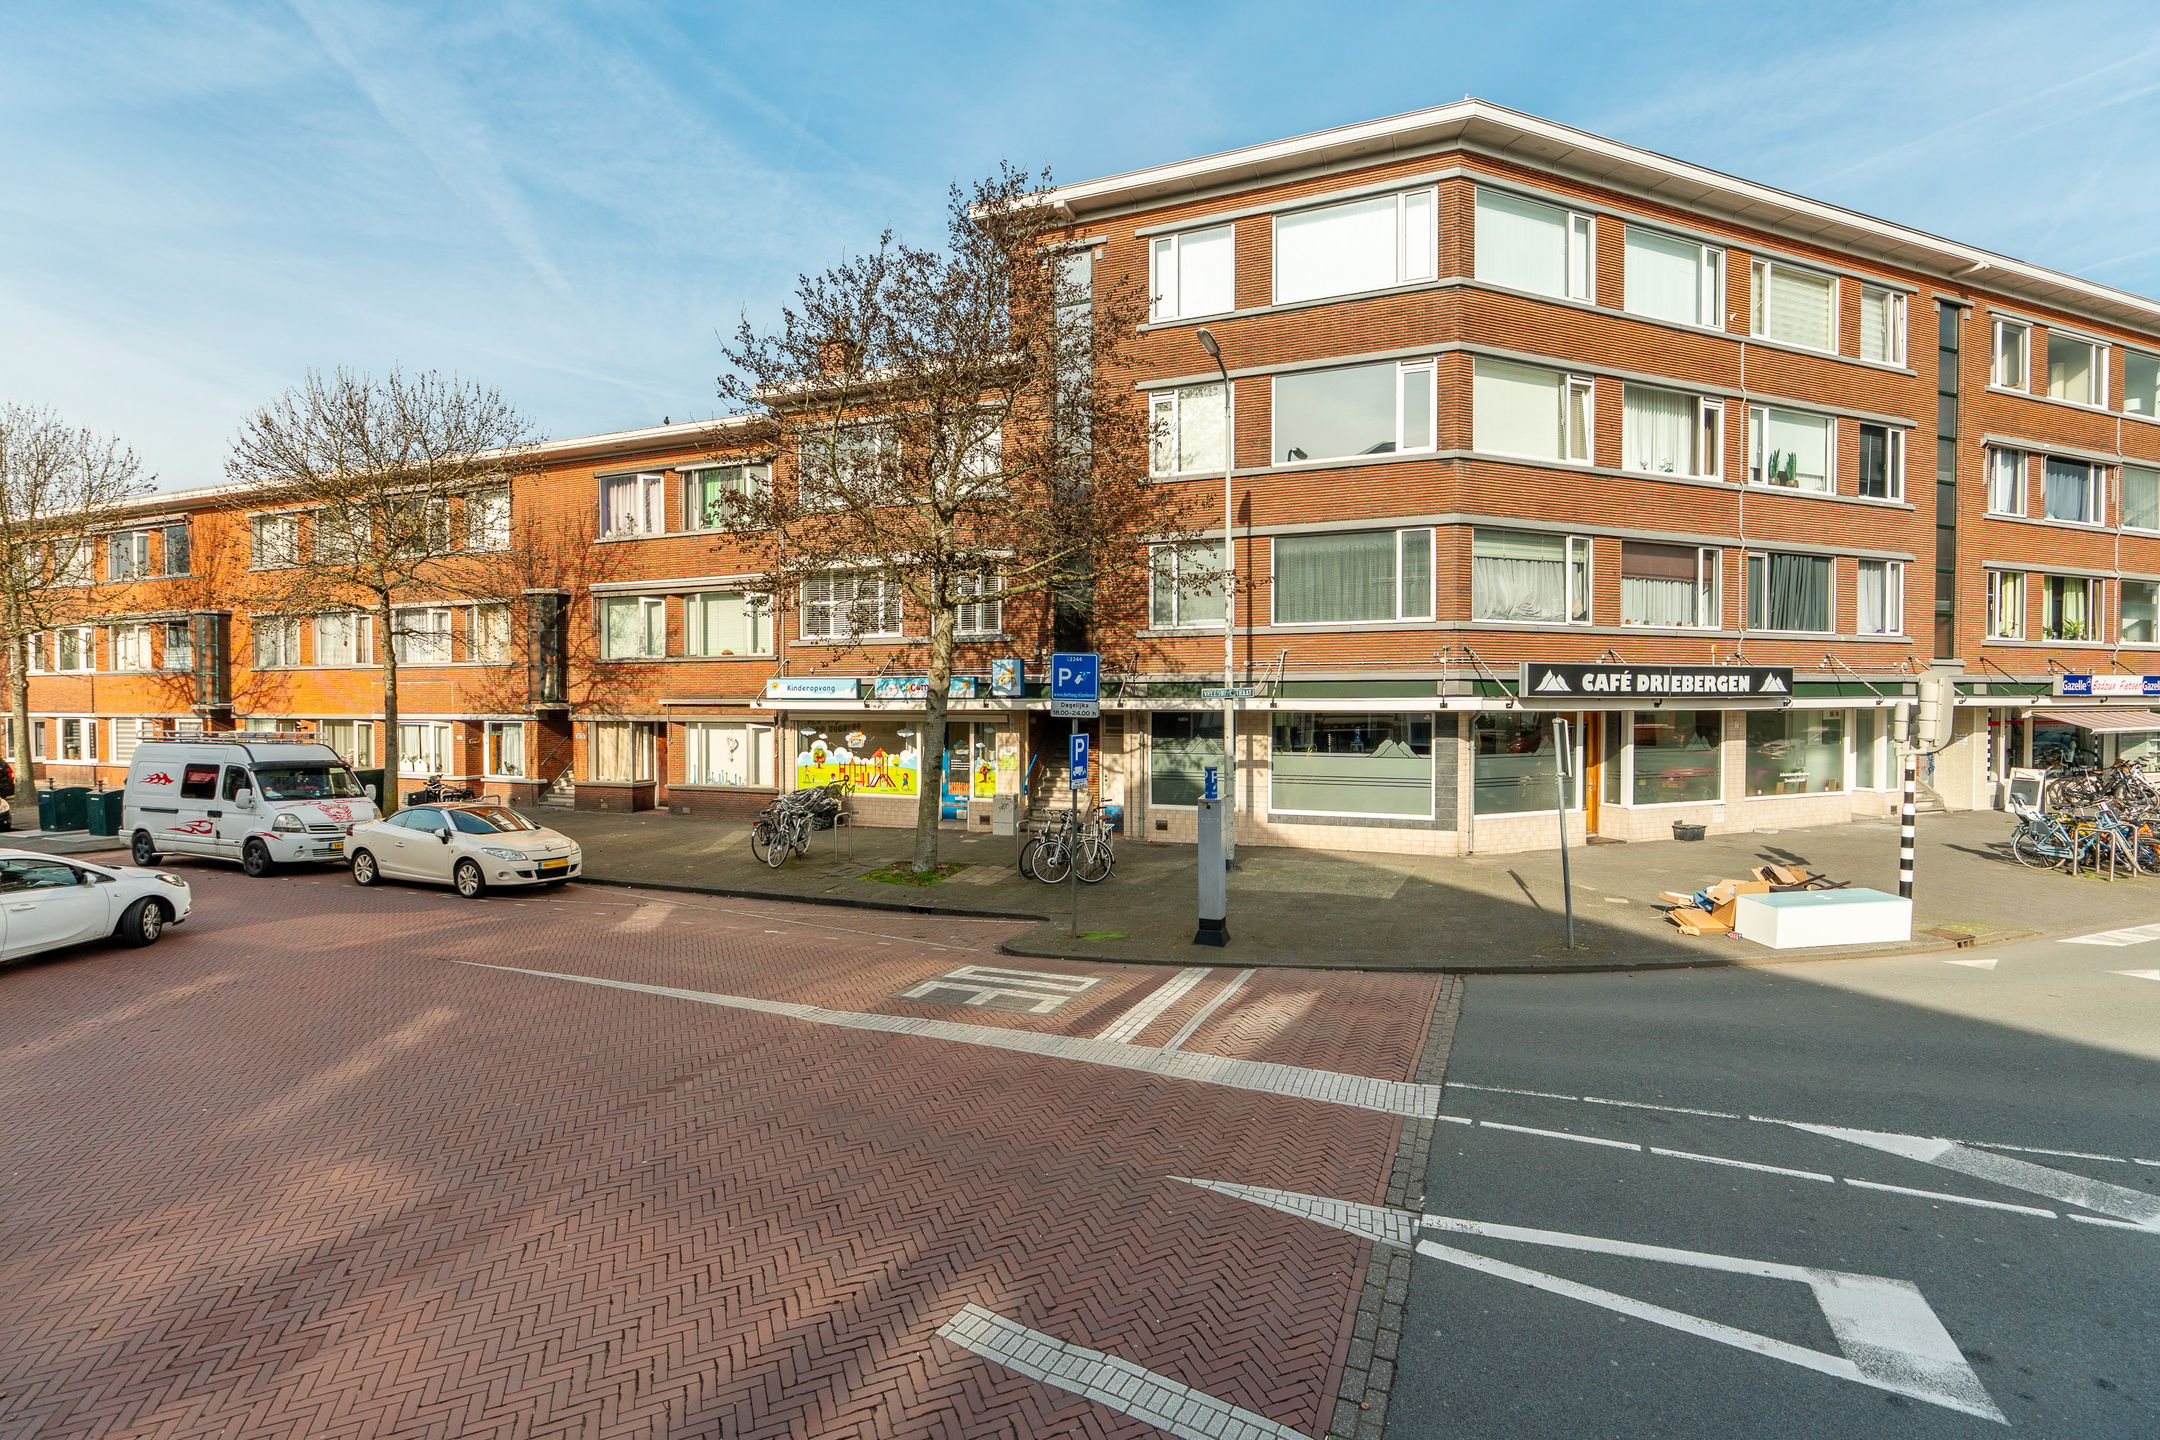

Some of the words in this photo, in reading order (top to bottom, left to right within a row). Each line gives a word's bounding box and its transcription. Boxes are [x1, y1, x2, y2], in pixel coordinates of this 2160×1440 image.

[1582, 670, 1632, 692] CAFÉ
[1636, 673, 1750, 693] DRIEBERGEN
[2063, 680, 2087, 691] Gazelle
[2143, 680, 2160, 691] Gazel
[786, 684, 836, 693] Kinderopvang
[1075, 738, 1084, 761] P
